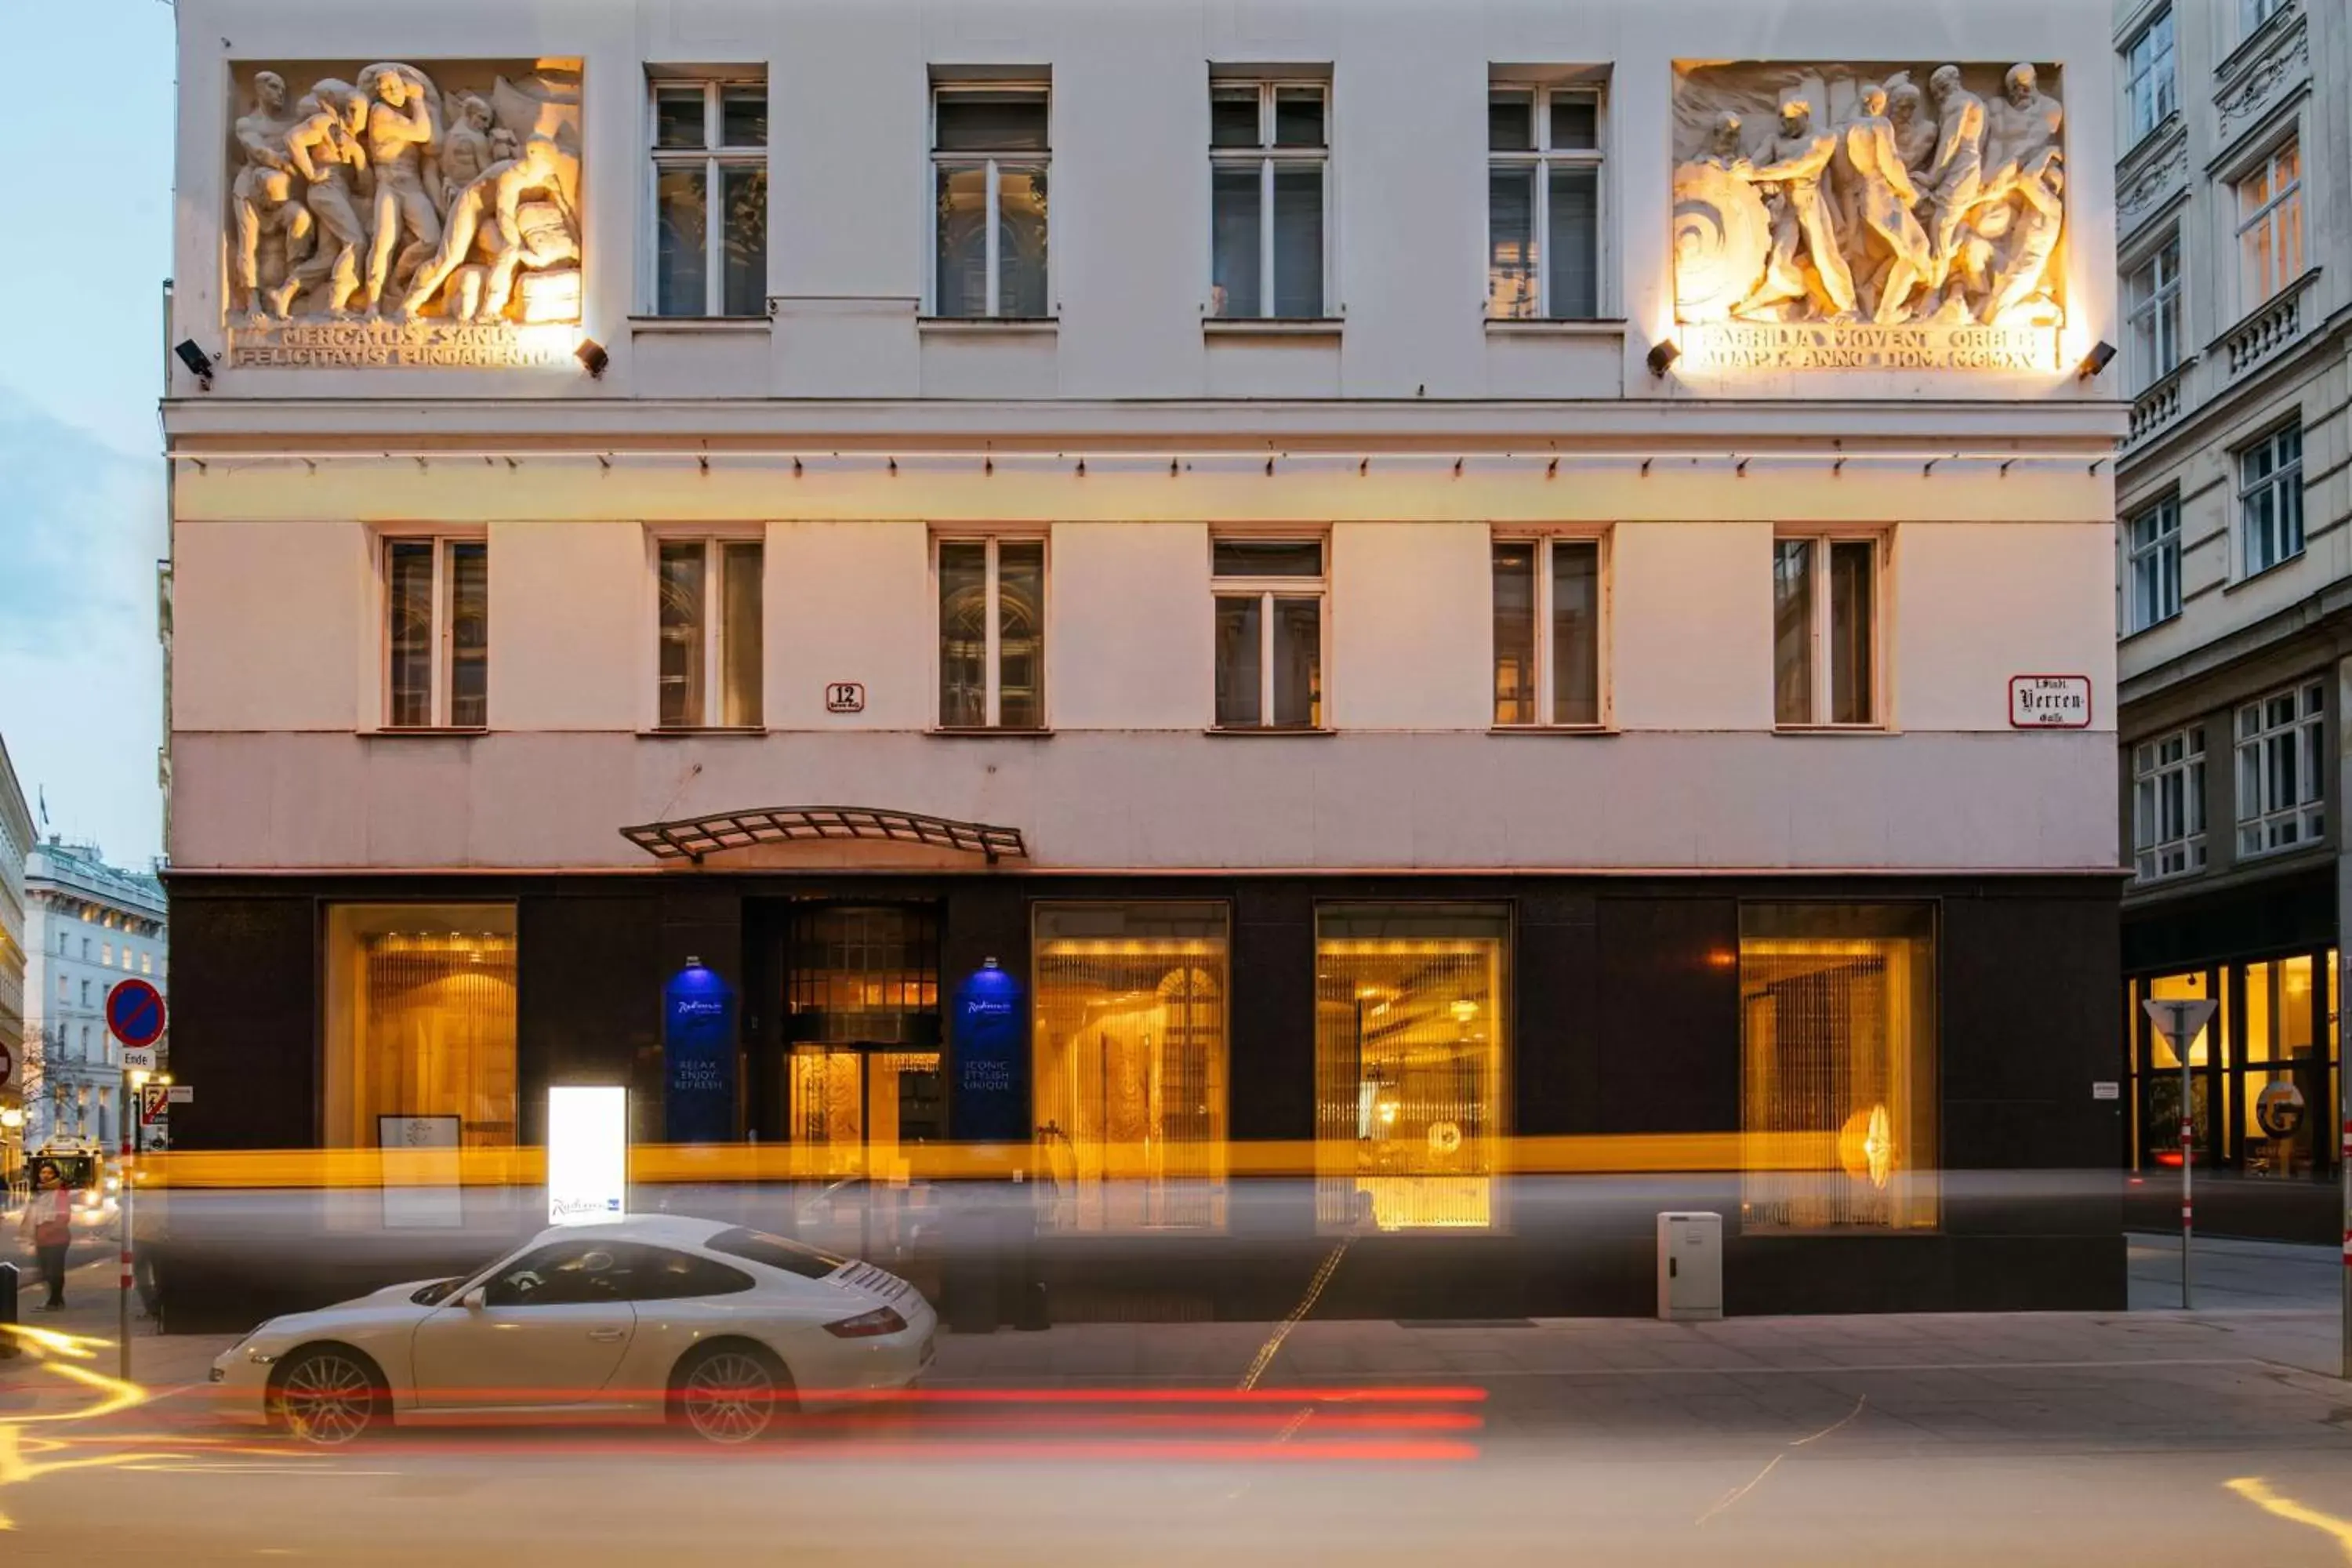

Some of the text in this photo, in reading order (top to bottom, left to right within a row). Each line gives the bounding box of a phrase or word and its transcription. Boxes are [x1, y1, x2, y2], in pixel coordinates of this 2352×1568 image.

[281, 326, 518, 346] MERCATUS SANUS
[1831, 328, 1934, 348] MOVENT
[238, 347, 389, 367] FELICITATIS
[1802, 350, 1866, 368] ANNO
[837, 686, 854, 702] 12
[125, 1053, 148, 1065] Ende
[964, 1061, 1008, 1070] ICONIC
[681, 1070, 717, 1080] ENJOY
